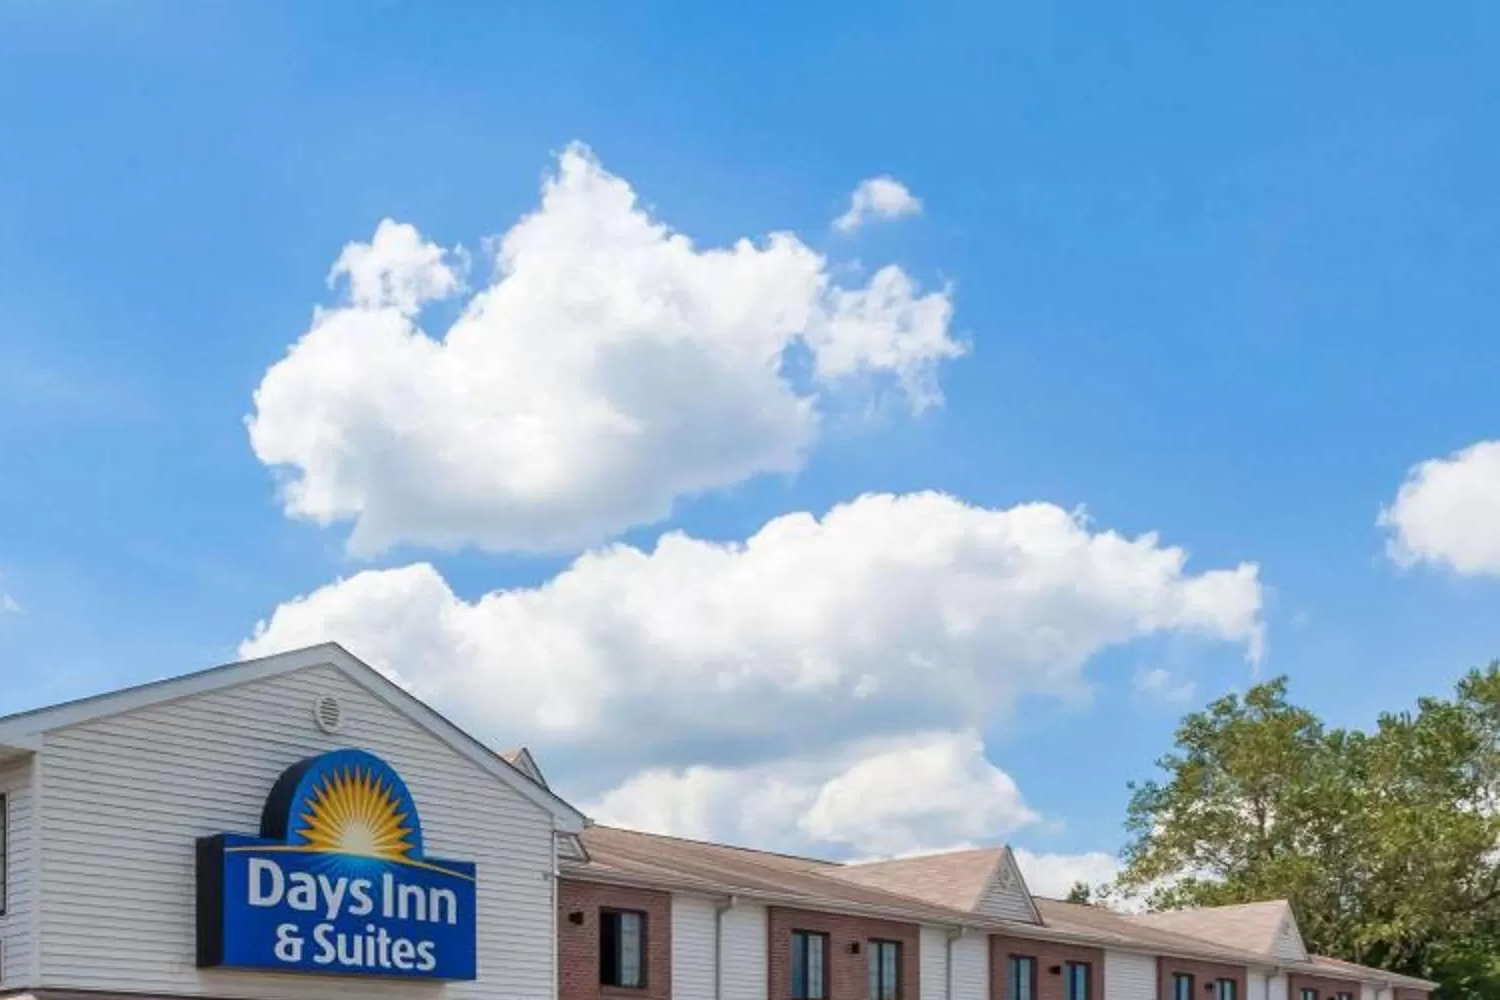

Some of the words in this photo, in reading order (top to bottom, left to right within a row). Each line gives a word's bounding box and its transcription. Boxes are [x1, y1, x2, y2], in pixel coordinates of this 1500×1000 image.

[248, 857, 373, 920] Days
[382, 873, 458, 925] Inn
[274, 923, 304, 963] &
[312, 923, 437, 972] Suites
